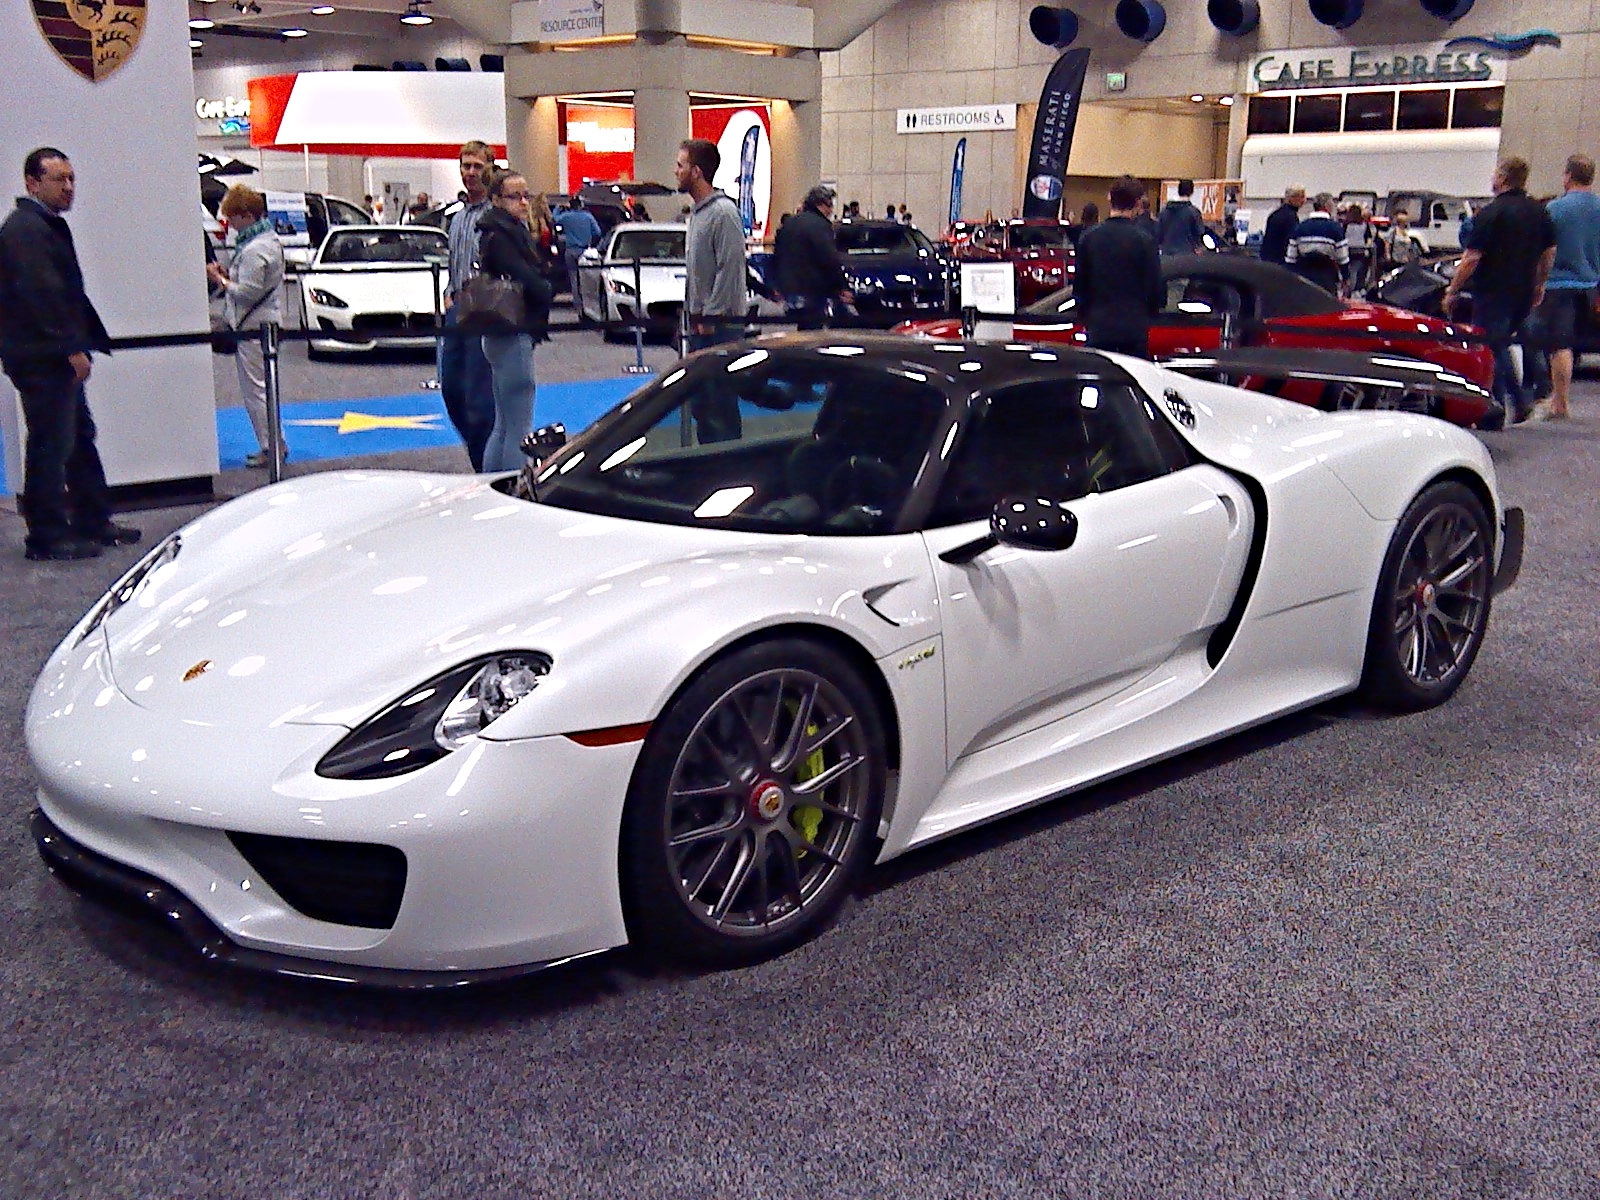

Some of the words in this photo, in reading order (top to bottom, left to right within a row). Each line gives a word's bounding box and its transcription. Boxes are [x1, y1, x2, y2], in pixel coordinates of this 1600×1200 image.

[1253, 55, 1333, 83] CAFE
[1349, 50, 1491, 80] EXPRESS
[920, 112, 991, 126] RESTROOMS
[1058, 93, 1072, 129] DIEGO
[1038, 90, 1061, 167] MASERATI
